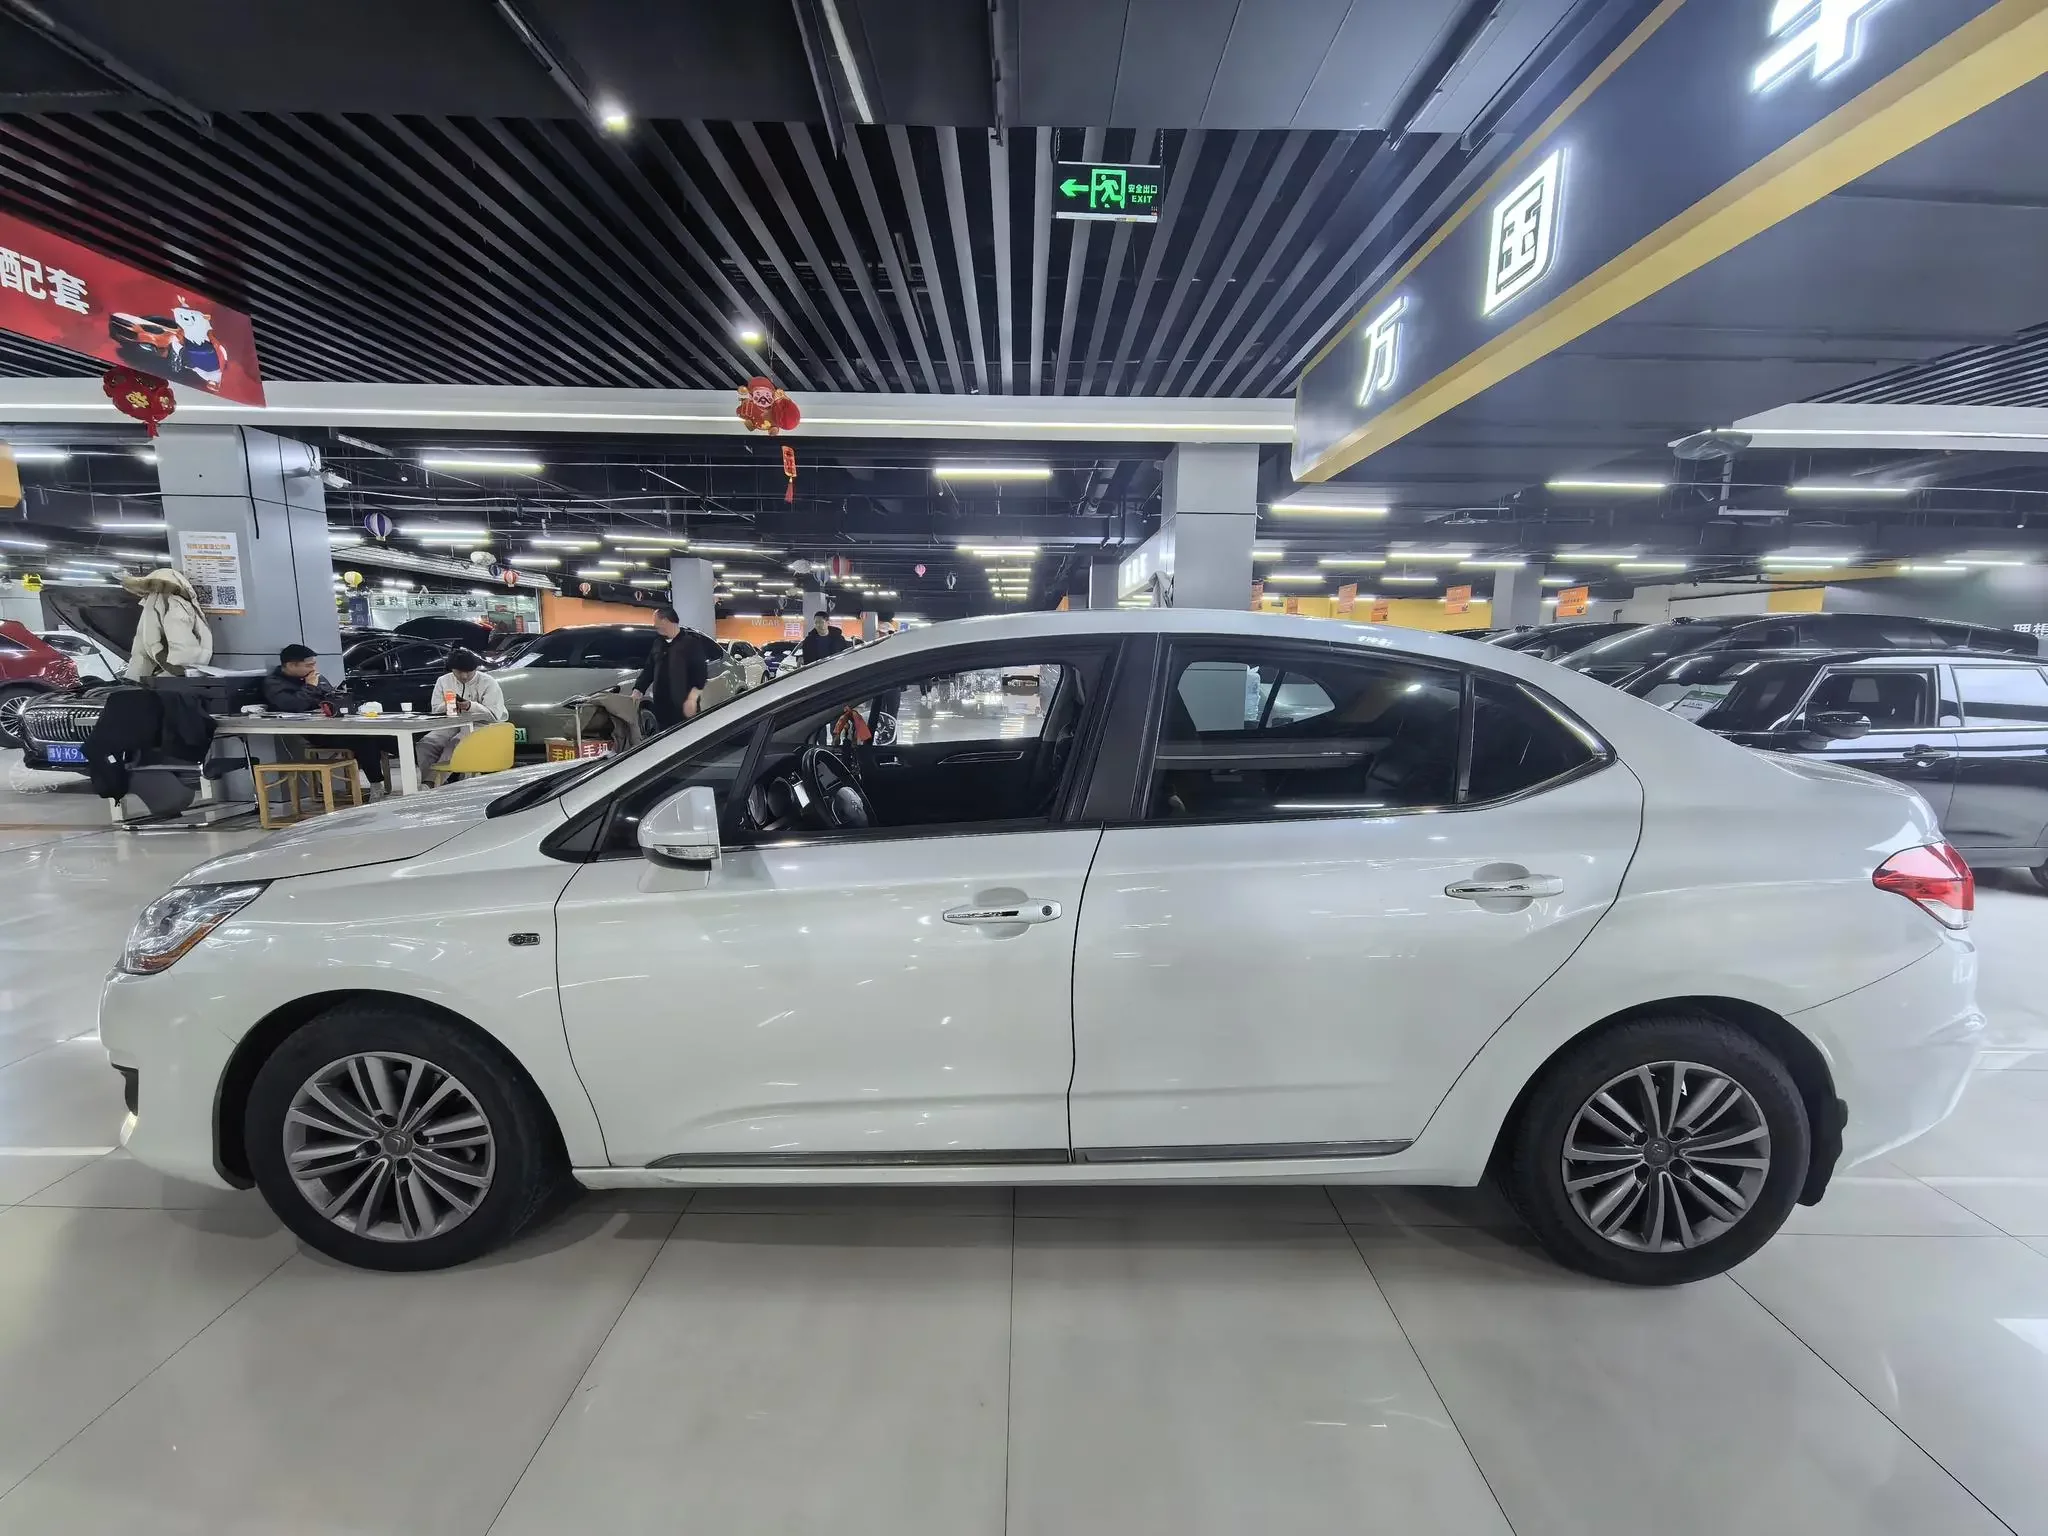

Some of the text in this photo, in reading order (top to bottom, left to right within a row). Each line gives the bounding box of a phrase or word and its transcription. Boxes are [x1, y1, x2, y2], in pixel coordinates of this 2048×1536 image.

[1127, 184, 1158, 194] 安全出口
[1131, 195, 1153, 204] EXIT
[0, 246, 90, 315] 配套
